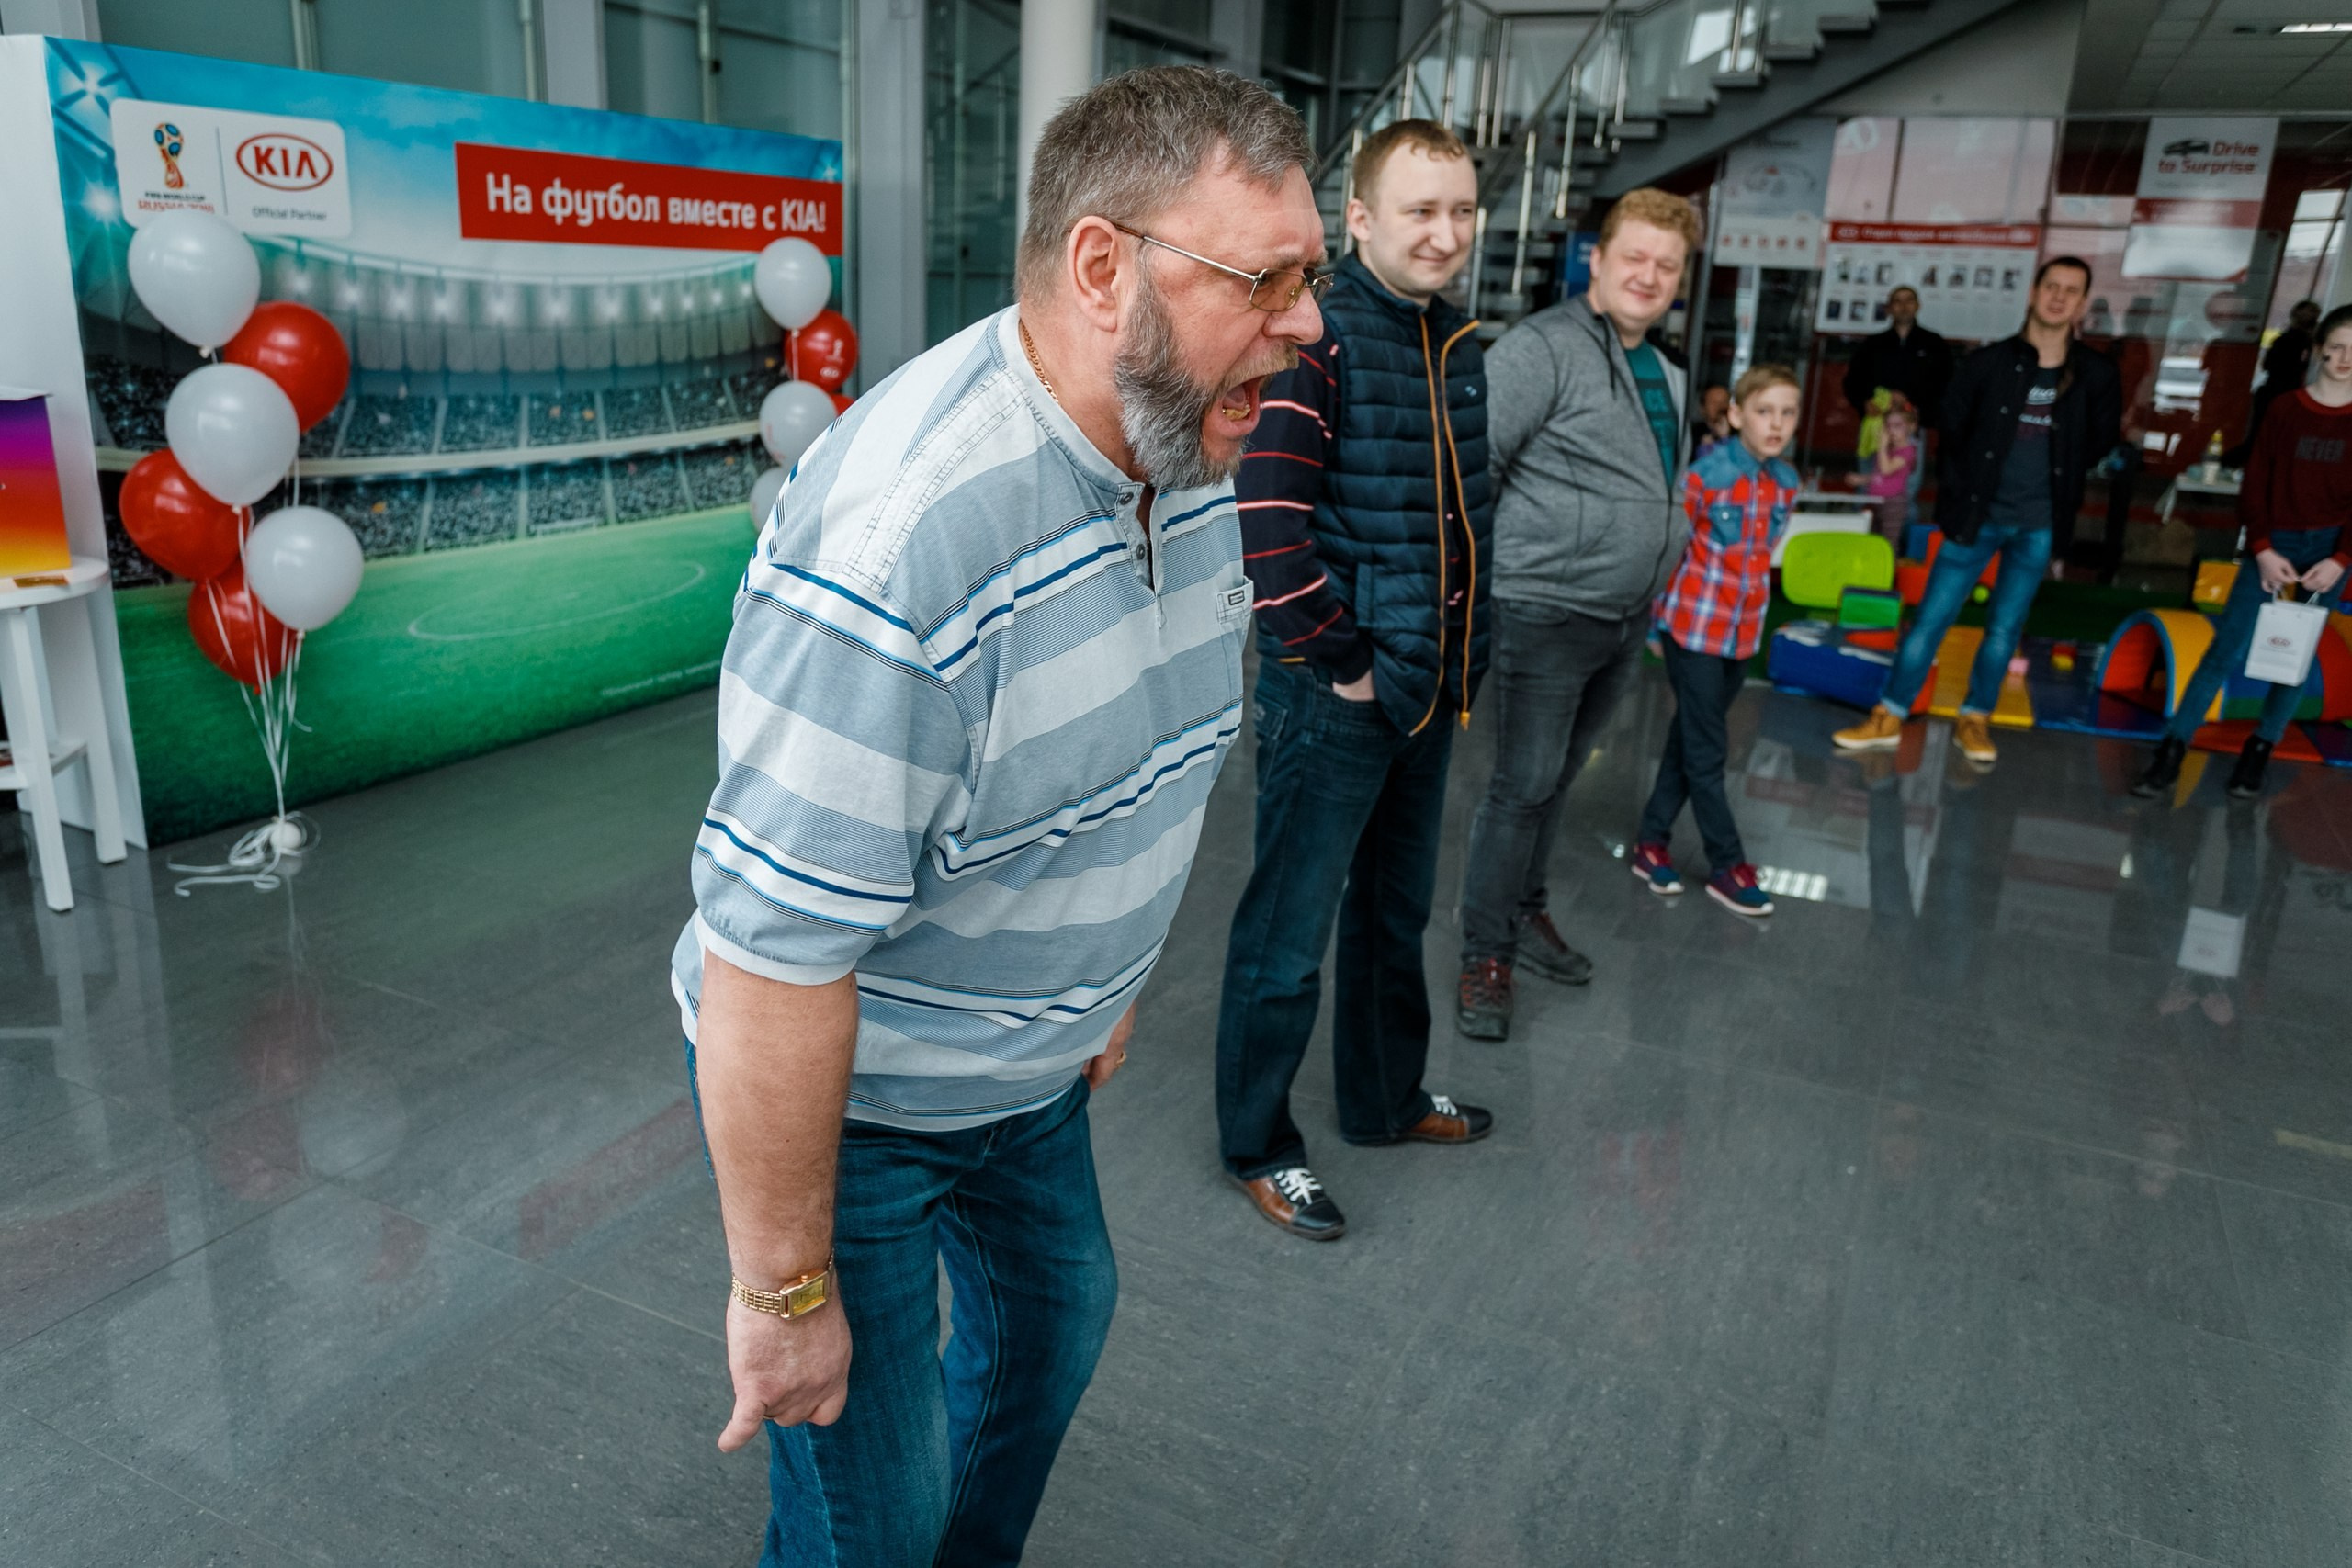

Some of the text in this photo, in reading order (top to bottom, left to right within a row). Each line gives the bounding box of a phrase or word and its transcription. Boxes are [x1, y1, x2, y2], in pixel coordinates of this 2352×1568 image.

[2212, 141, 2260, 156] Drive
[253, 144, 319, 180] KIA
[2158, 160, 2257, 175] to Surprise
[485, 171, 827, 233] На футбол вместе с KIA!
[252, 206, 327, 221] Official Partner
